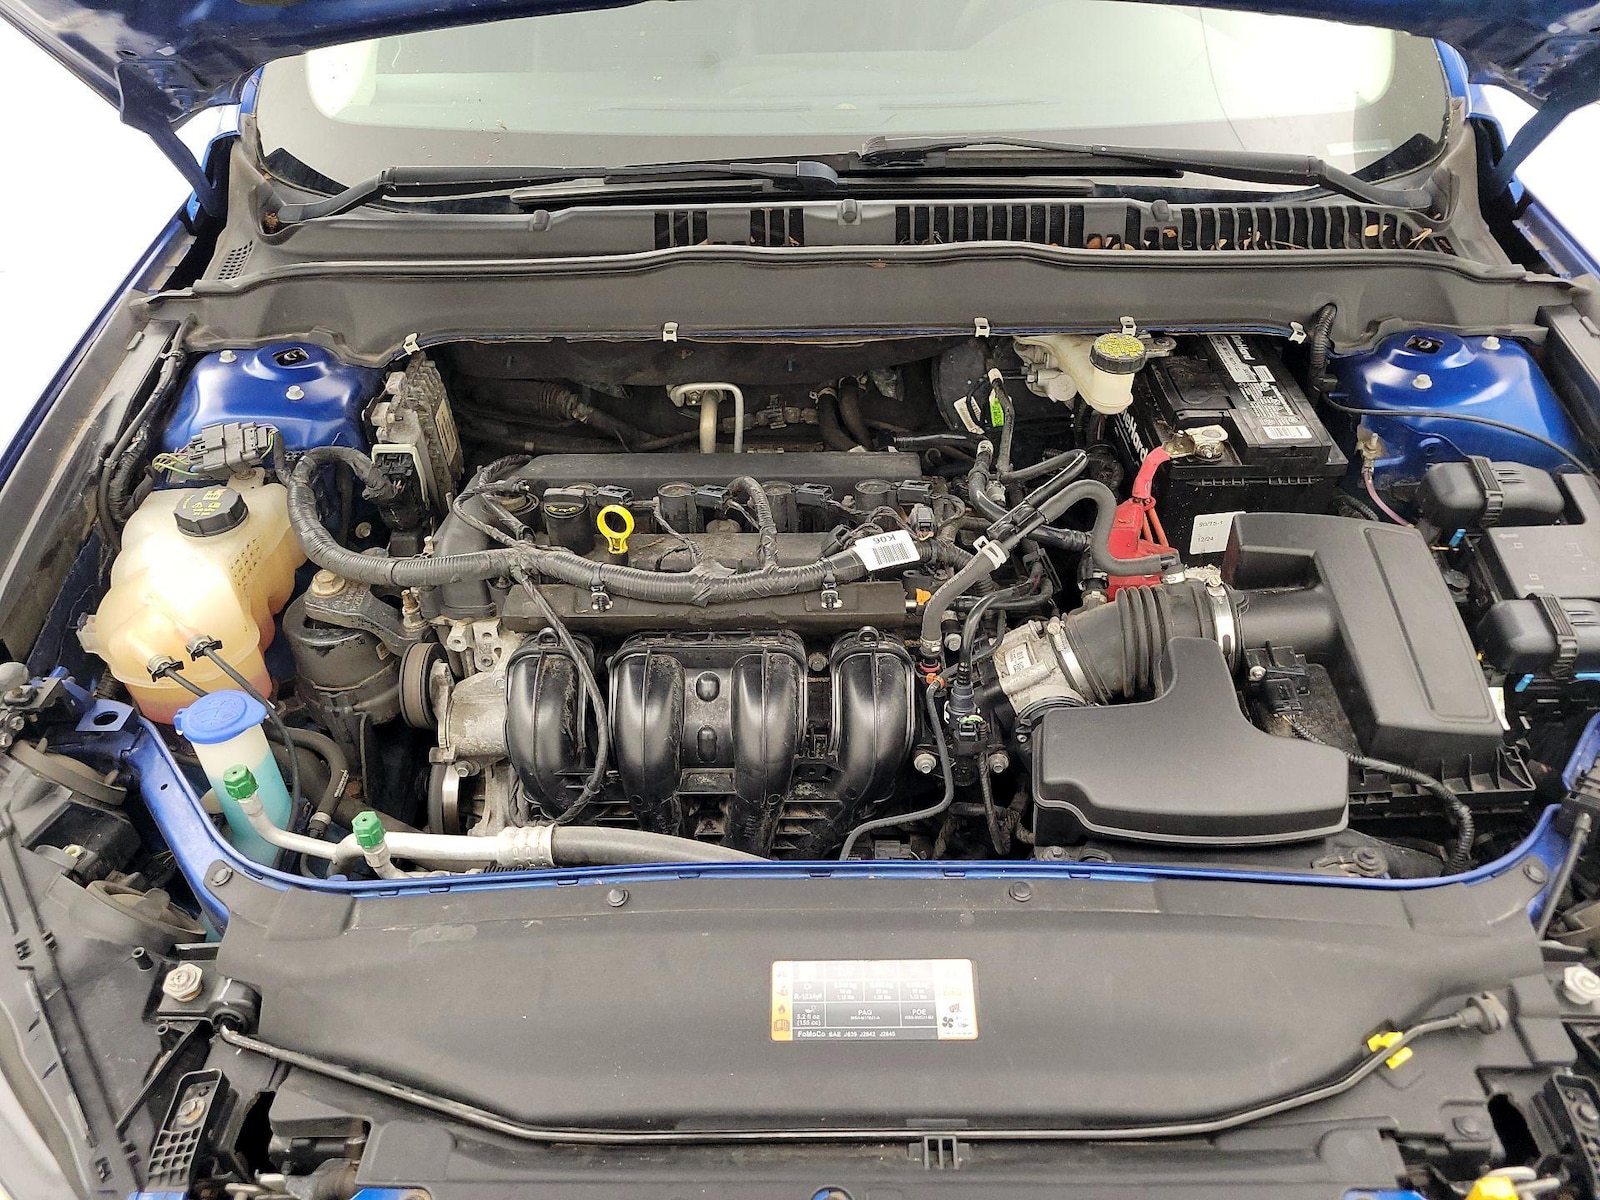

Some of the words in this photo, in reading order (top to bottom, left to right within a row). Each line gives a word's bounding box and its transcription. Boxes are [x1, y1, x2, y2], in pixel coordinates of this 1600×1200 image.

[1121, 407, 1149, 463] ieHard
[872, 533, 896, 545] K06
[793, 993, 823, 1001] R-1234yf
[857, 1008, 873, 1016] PAG
[912, 1008, 927, 1016] POE
[797, 1030, 826, 1038] FoMoCo
